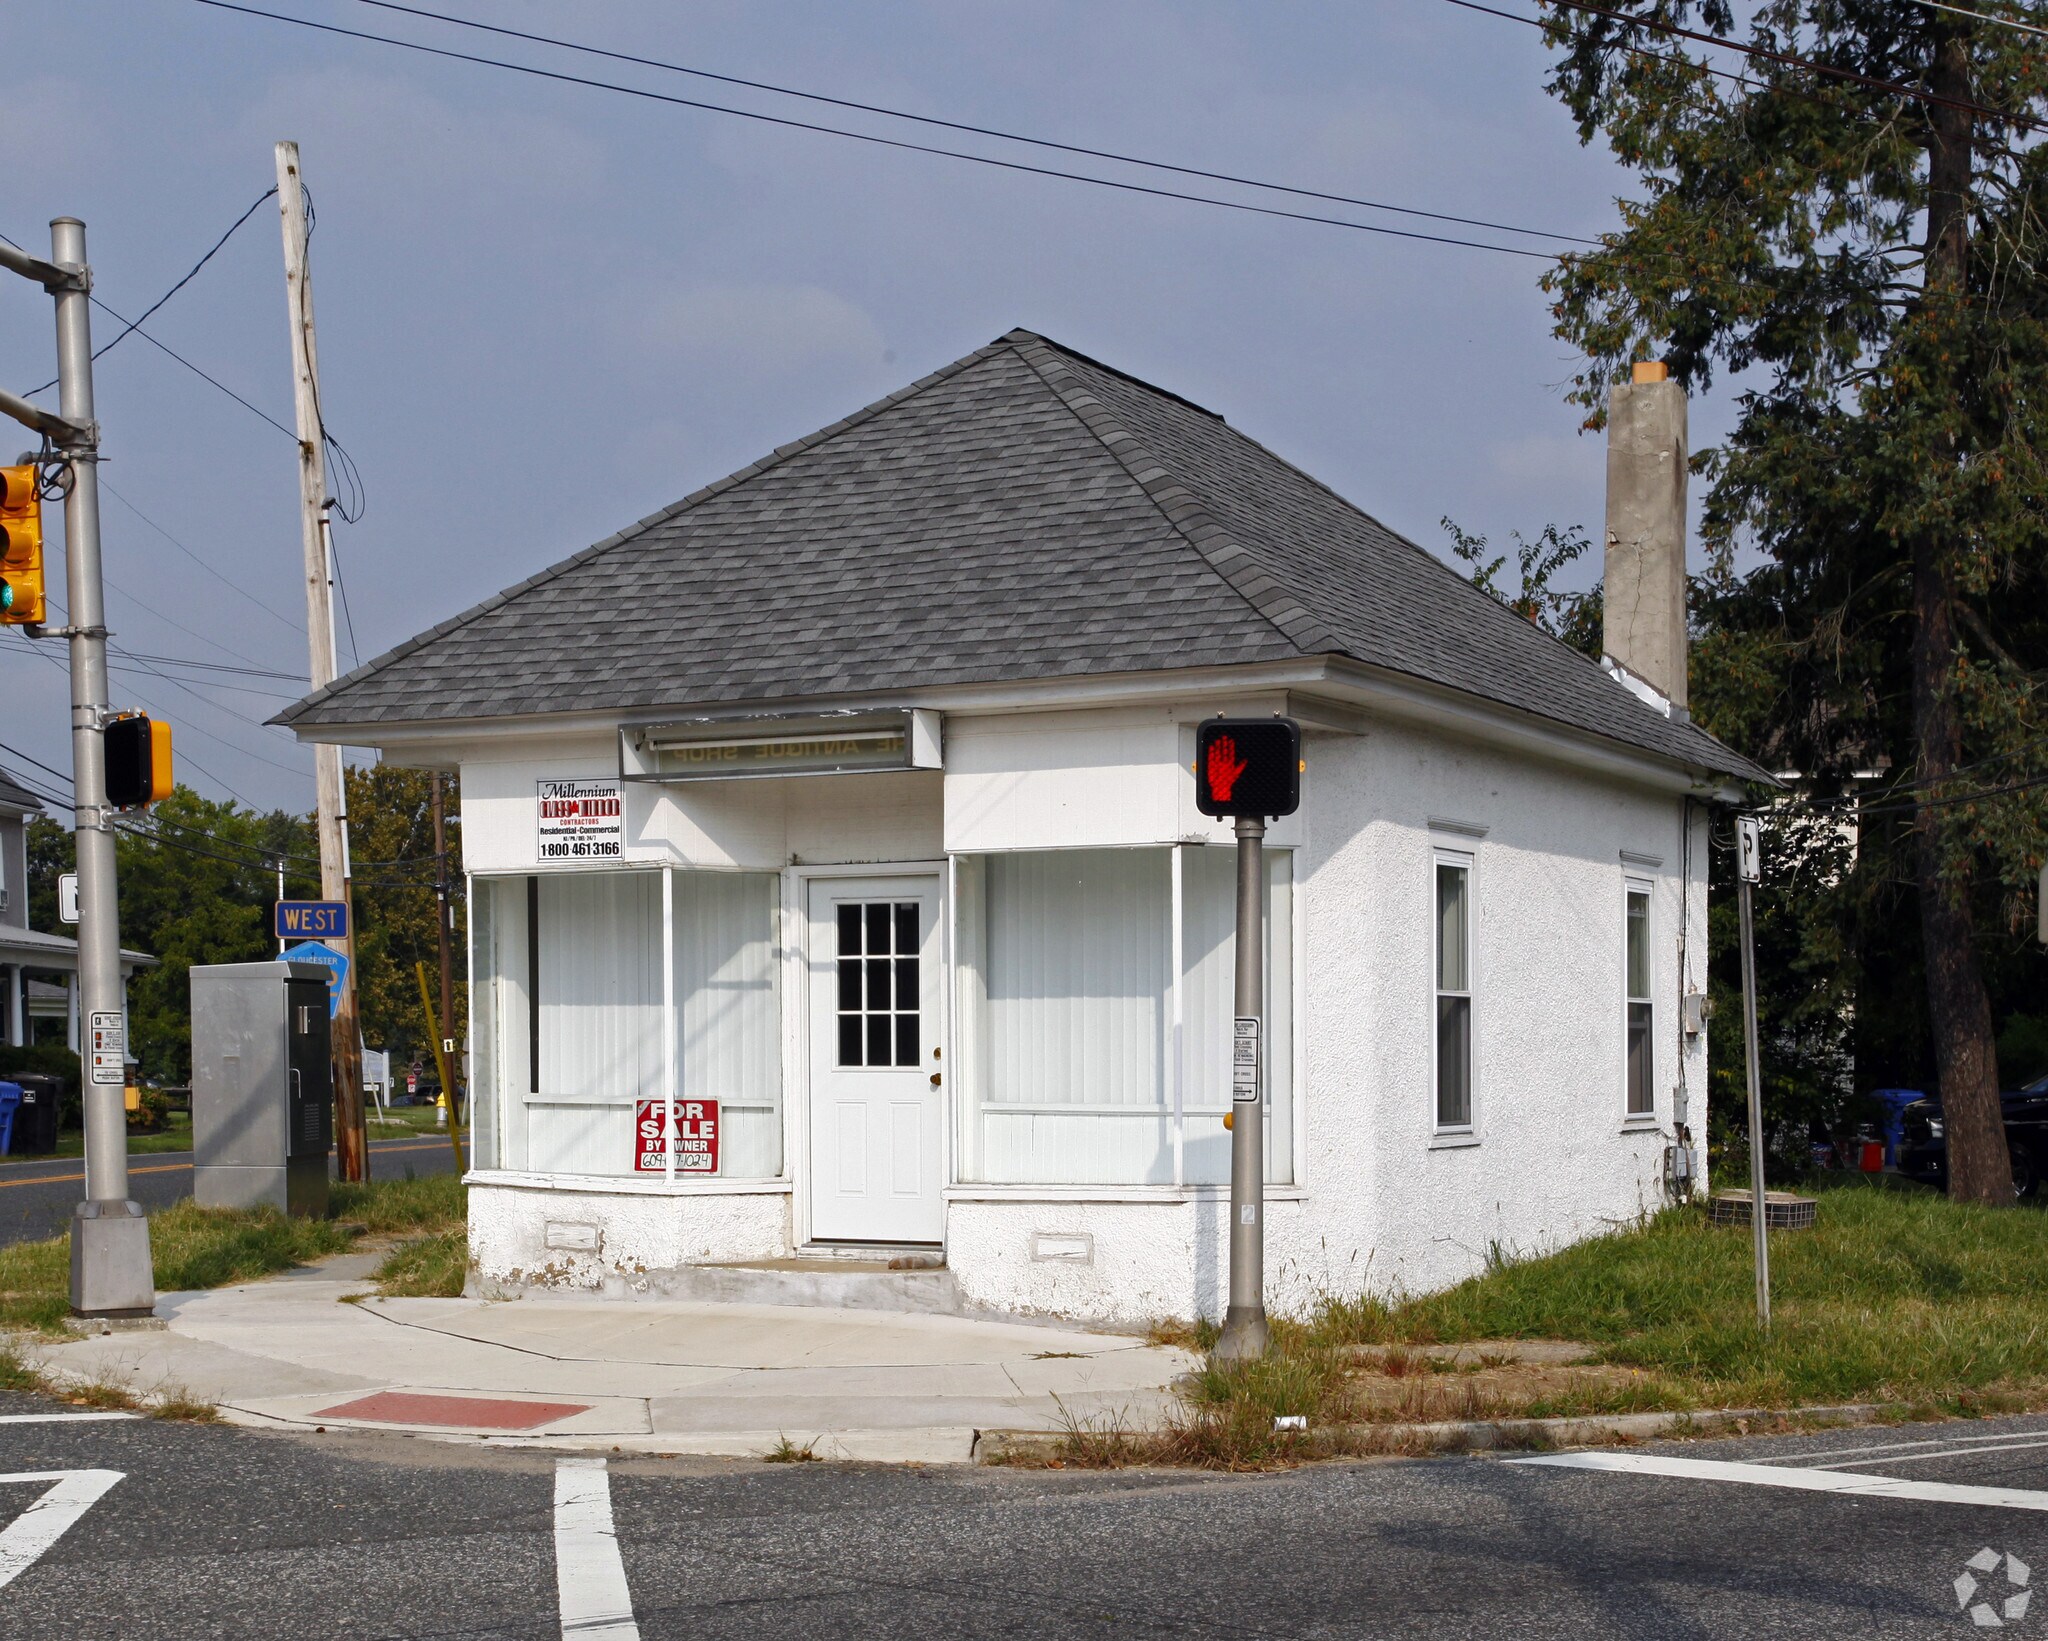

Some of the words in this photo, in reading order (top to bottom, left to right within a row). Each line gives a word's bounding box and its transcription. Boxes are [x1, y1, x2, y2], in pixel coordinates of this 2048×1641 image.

[542, 783, 616, 799] Millennium
[284, 909, 337, 931] WEST
[650, 1103, 704, 1119] FOR
[640, 1120, 715, 1139] SALE
[646, 1140, 662, 1151] BY
[674, 1140, 708, 1151] WNER
